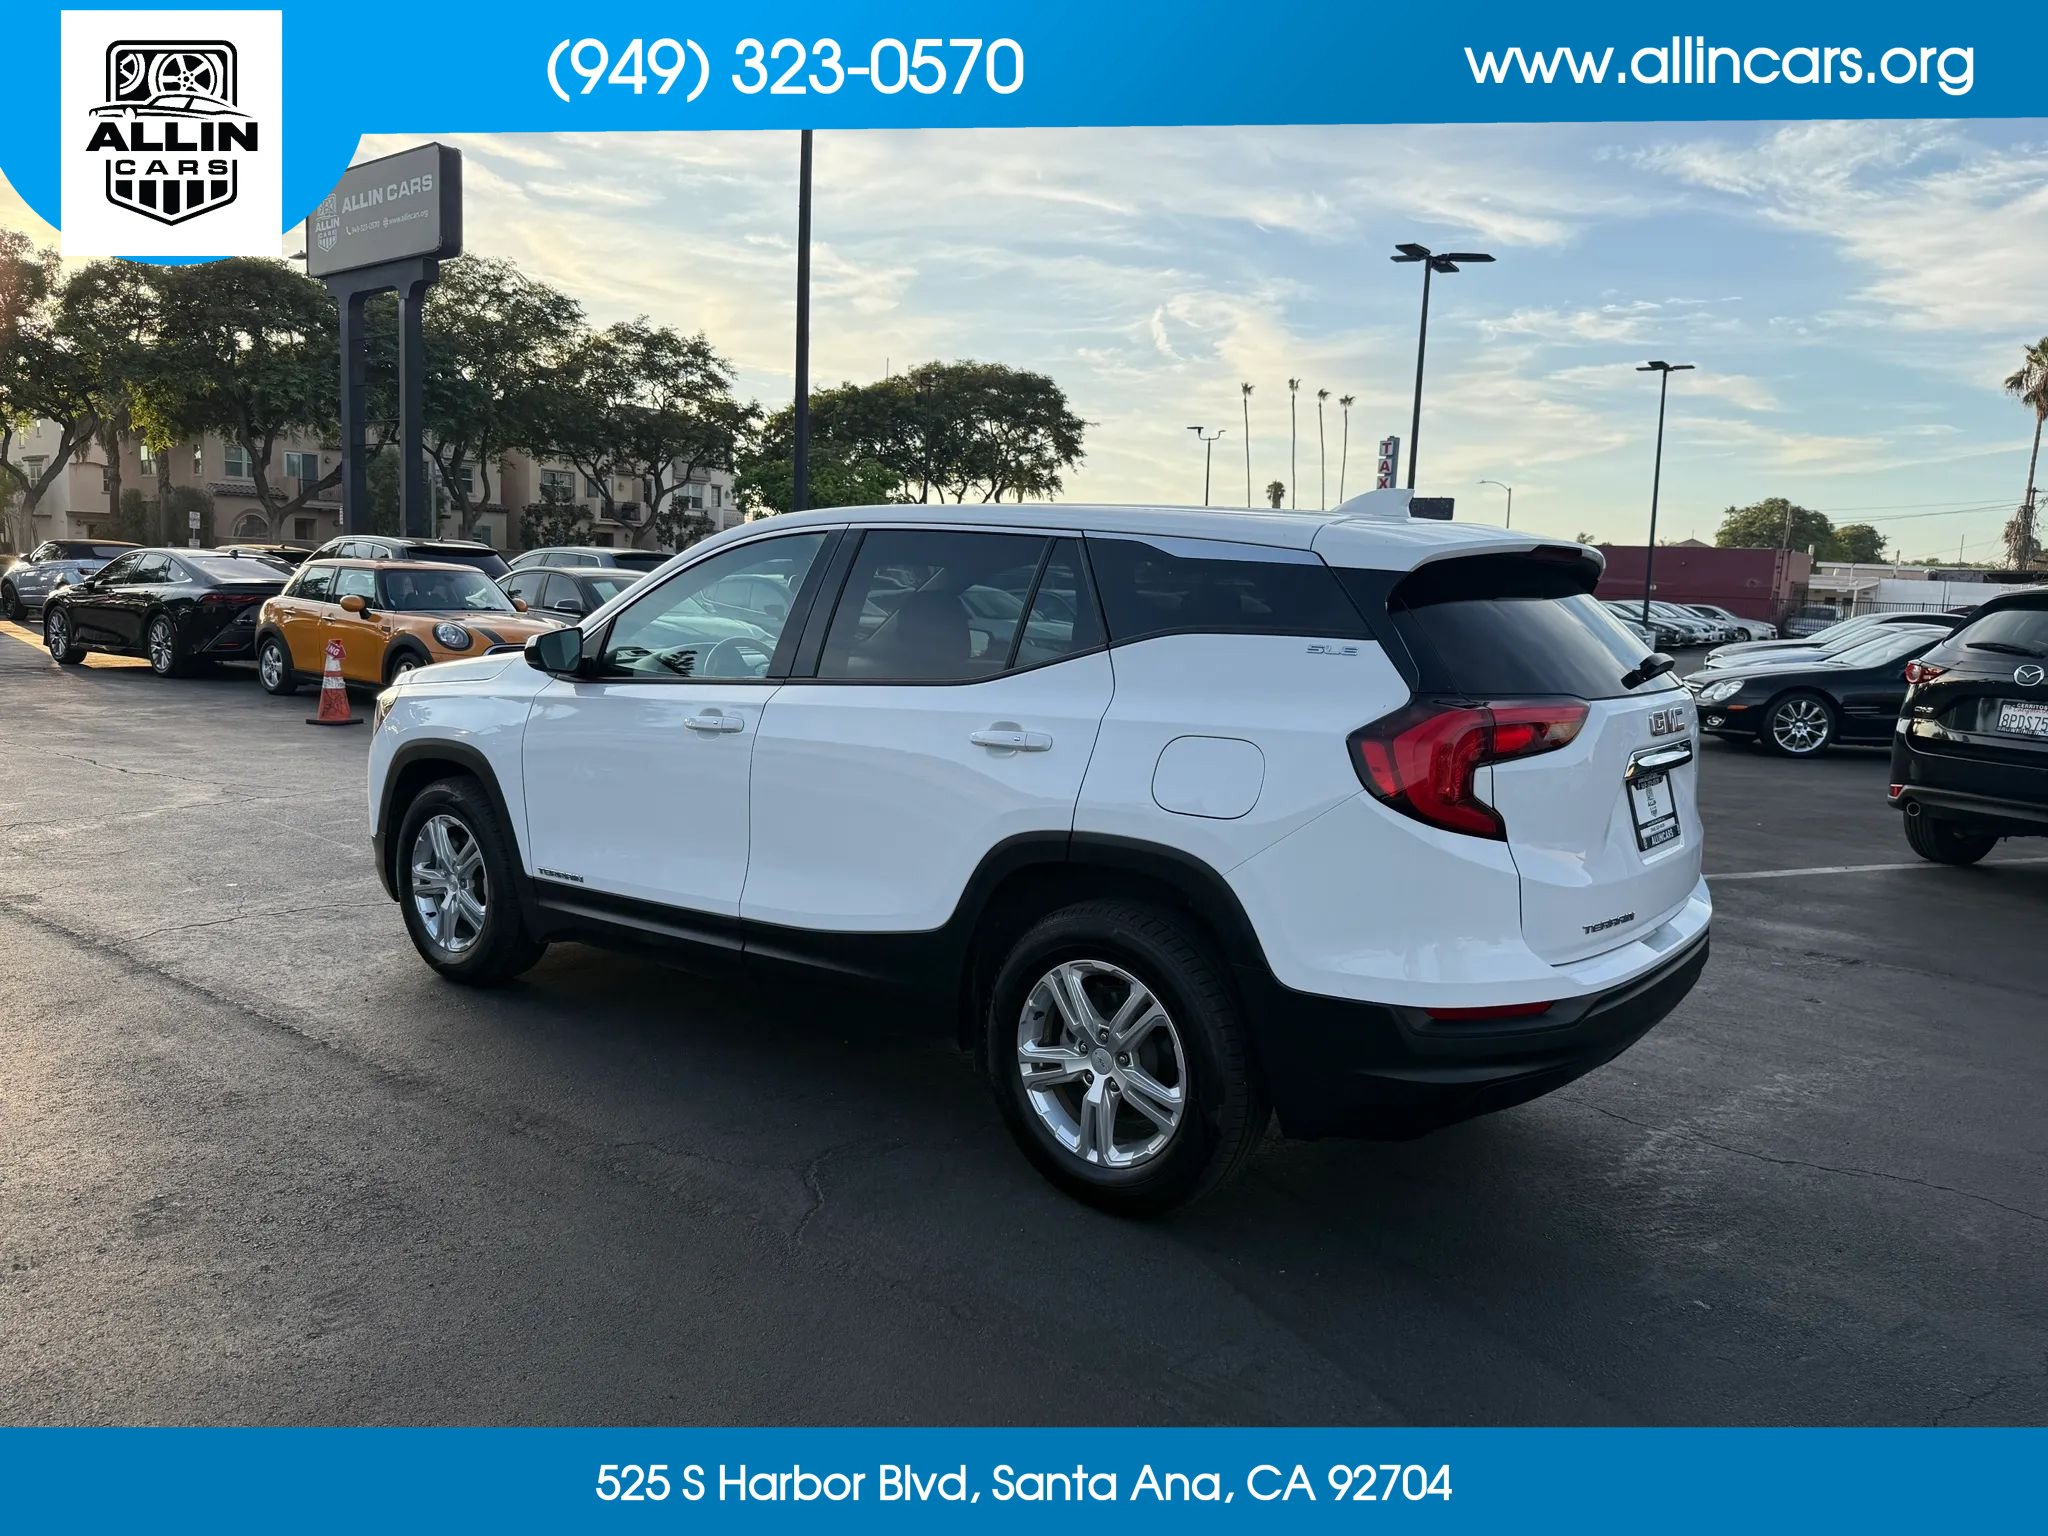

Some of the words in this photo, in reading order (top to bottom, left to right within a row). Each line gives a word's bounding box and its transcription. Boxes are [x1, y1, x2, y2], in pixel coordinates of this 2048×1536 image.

[341, 187, 383, 214] ALLIN
[387, 174, 433, 201] CARS
[315, 216, 340, 233] ALLIN
[1379, 442, 1392, 489] TAX
[1305, 644, 1359, 657] SLE
[1649, 707, 1685, 737] GMC
